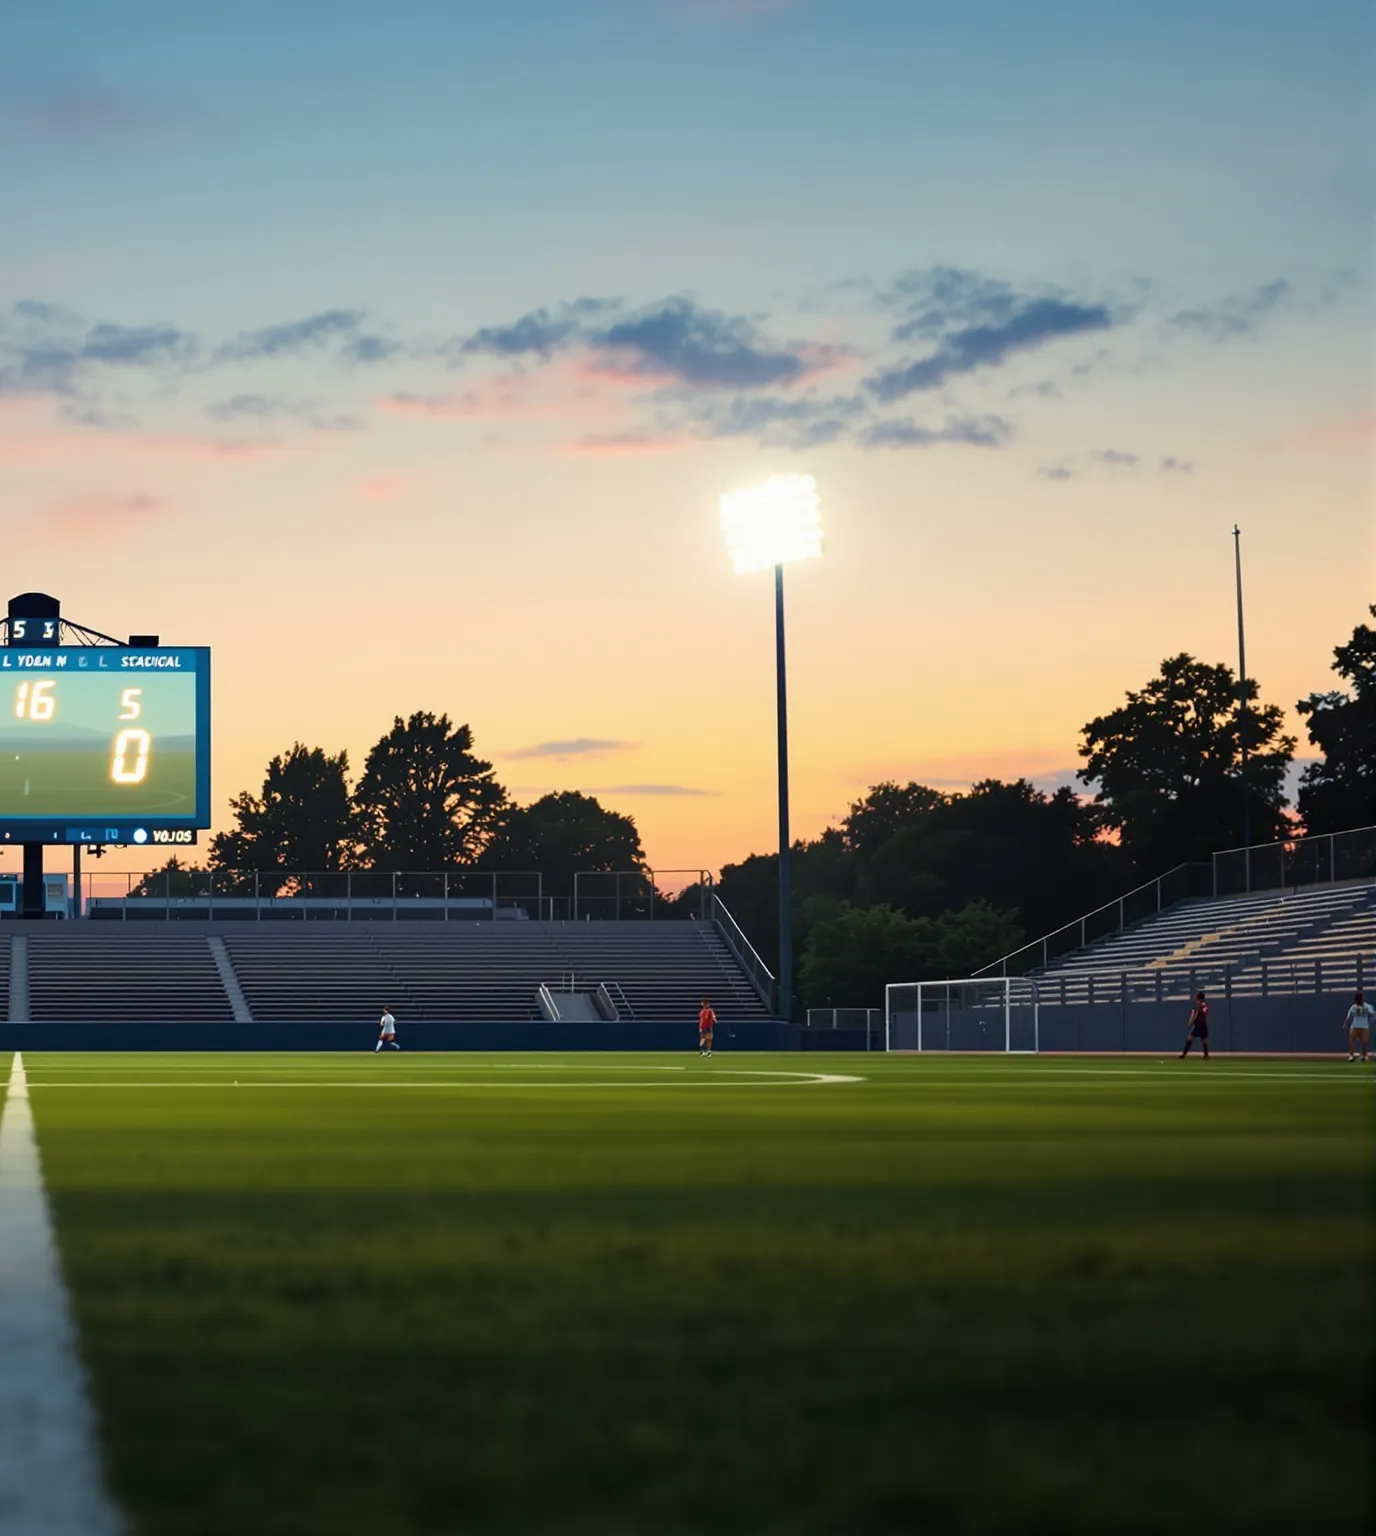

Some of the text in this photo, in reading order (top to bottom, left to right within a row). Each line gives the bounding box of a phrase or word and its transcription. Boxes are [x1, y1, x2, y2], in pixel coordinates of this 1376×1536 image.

[13, 620, 26, 639] 5
[2, 655, 12, 667] L
[15, 680, 57, 720] 16
[118, 688, 143, 720] 5
[111, 728, 151, 784] 0
